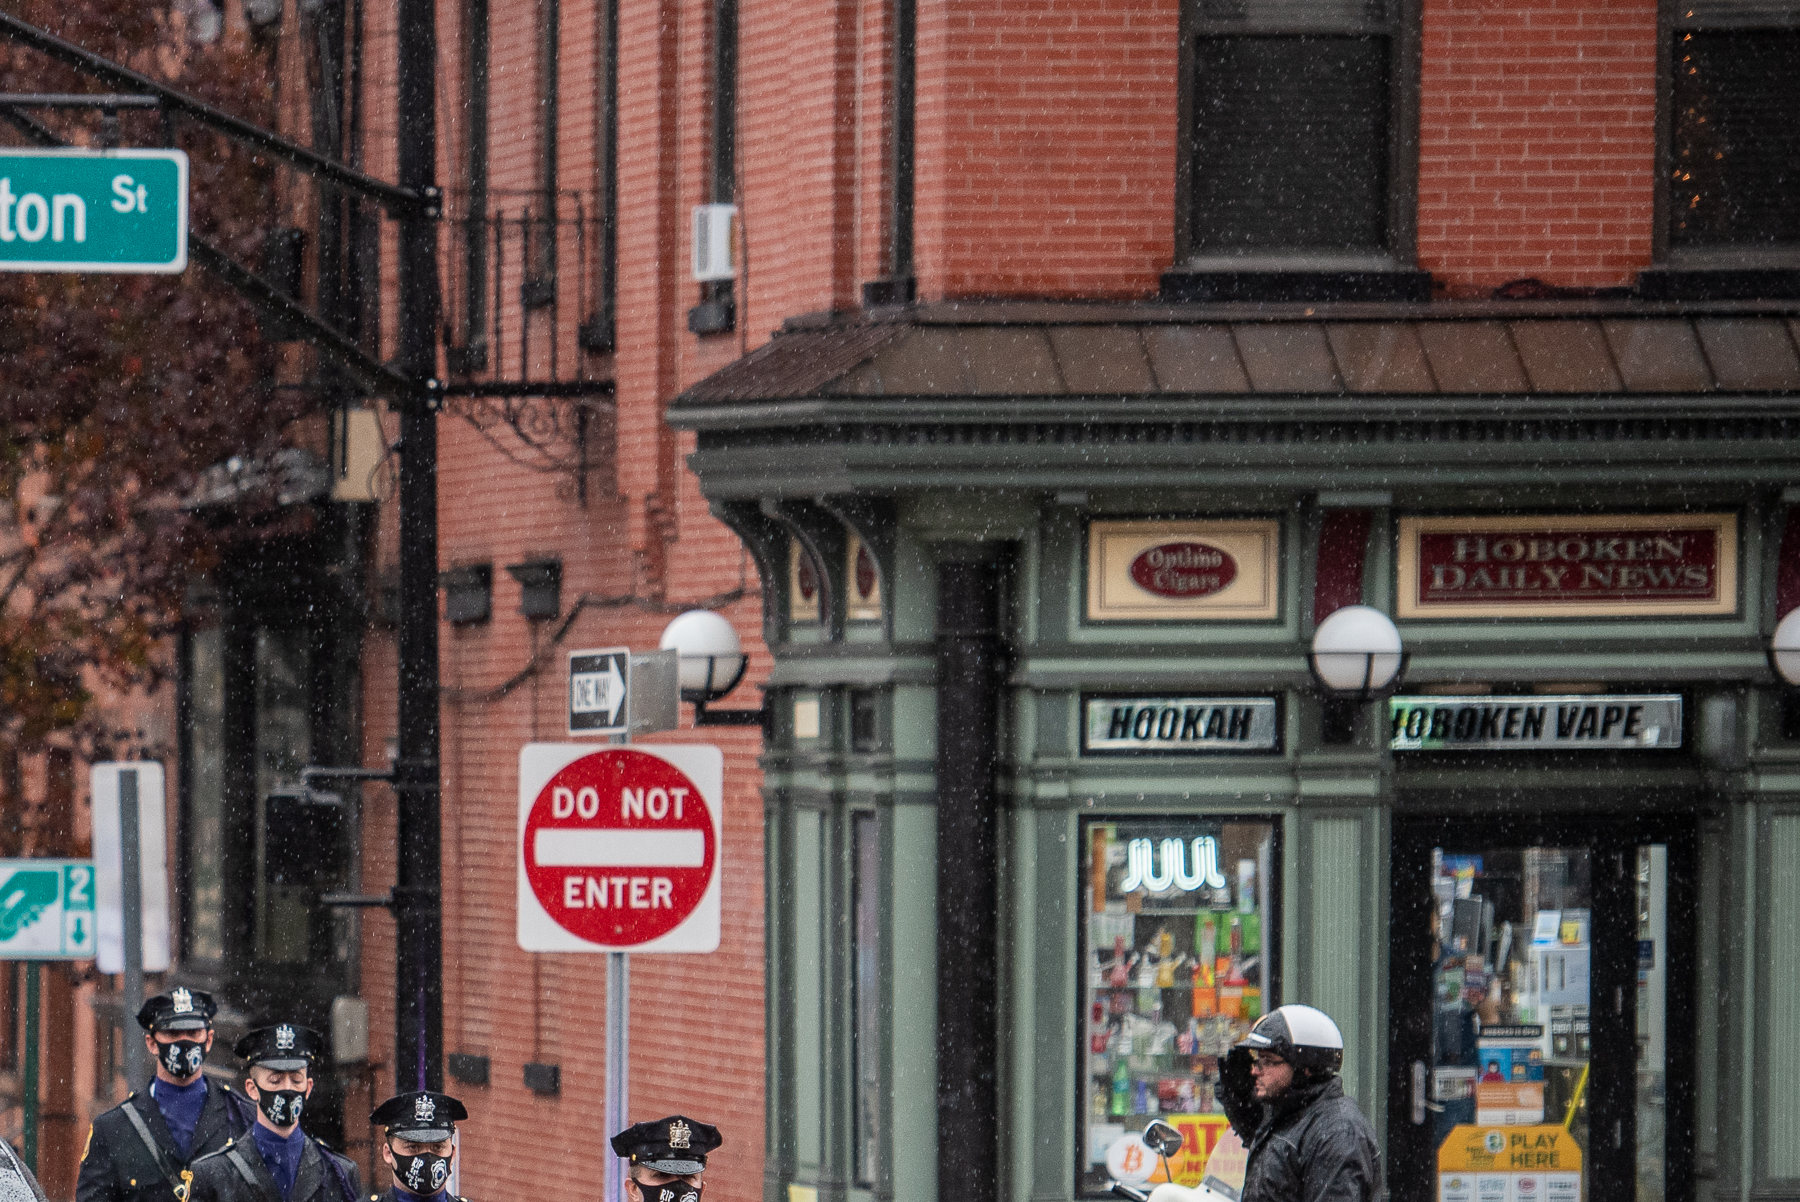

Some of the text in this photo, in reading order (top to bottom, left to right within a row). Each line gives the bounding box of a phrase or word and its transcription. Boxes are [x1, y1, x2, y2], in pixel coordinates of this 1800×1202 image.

[111, 175, 148, 214] St
[1147, 548, 1223, 570] Optimo
[1454, 536, 1686, 564] HOBOKEN
[1153, 570, 1220, 591] Cigars
[1429, 563, 1710, 591] DAILY NEWS
[576, 675, 592, 707] ONE
[1108, 706, 1254, 741] HOOKAH
[1556, 706, 1644, 740] VAPE
[552, 786, 689, 820] DO NOT
[1121, 835, 1226, 893] JUUL
[69, 868, 91, 901] 2
[563, 876, 673, 910] ENTER
[1510, 1133, 1559, 1149] PLAY
[411, 1156, 424, 1168] RIP
[1510, 1152, 1559, 1168] HERE
[659, 1188, 675, 1202] RIP
